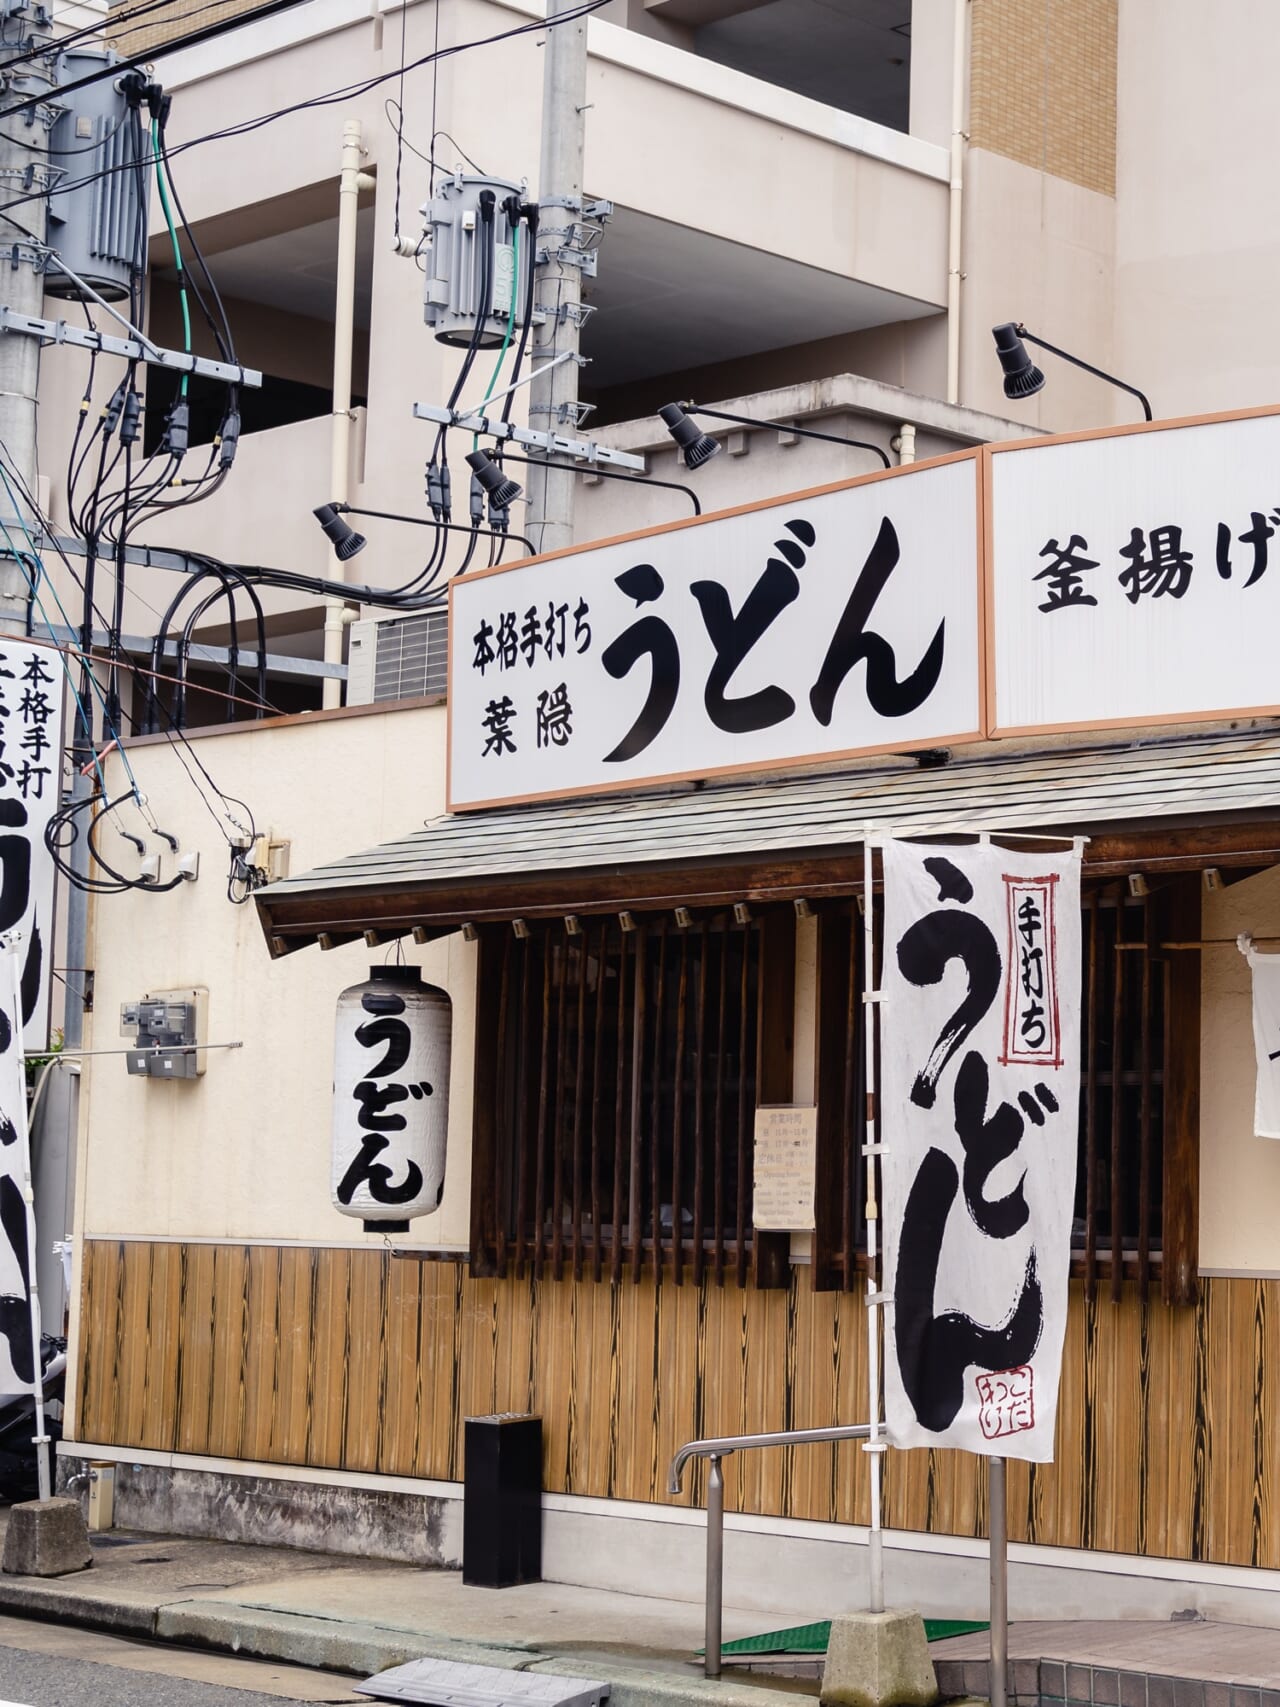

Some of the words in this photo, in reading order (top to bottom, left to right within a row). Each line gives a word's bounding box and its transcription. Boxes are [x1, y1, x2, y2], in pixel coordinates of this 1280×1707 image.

[16, 653, 56, 799] 本格手打
[1018, 896, 1046, 1049] 手打ち
[336, 992, 434, 1206] うどん
[895, 856, 1060, 1432] うどん
